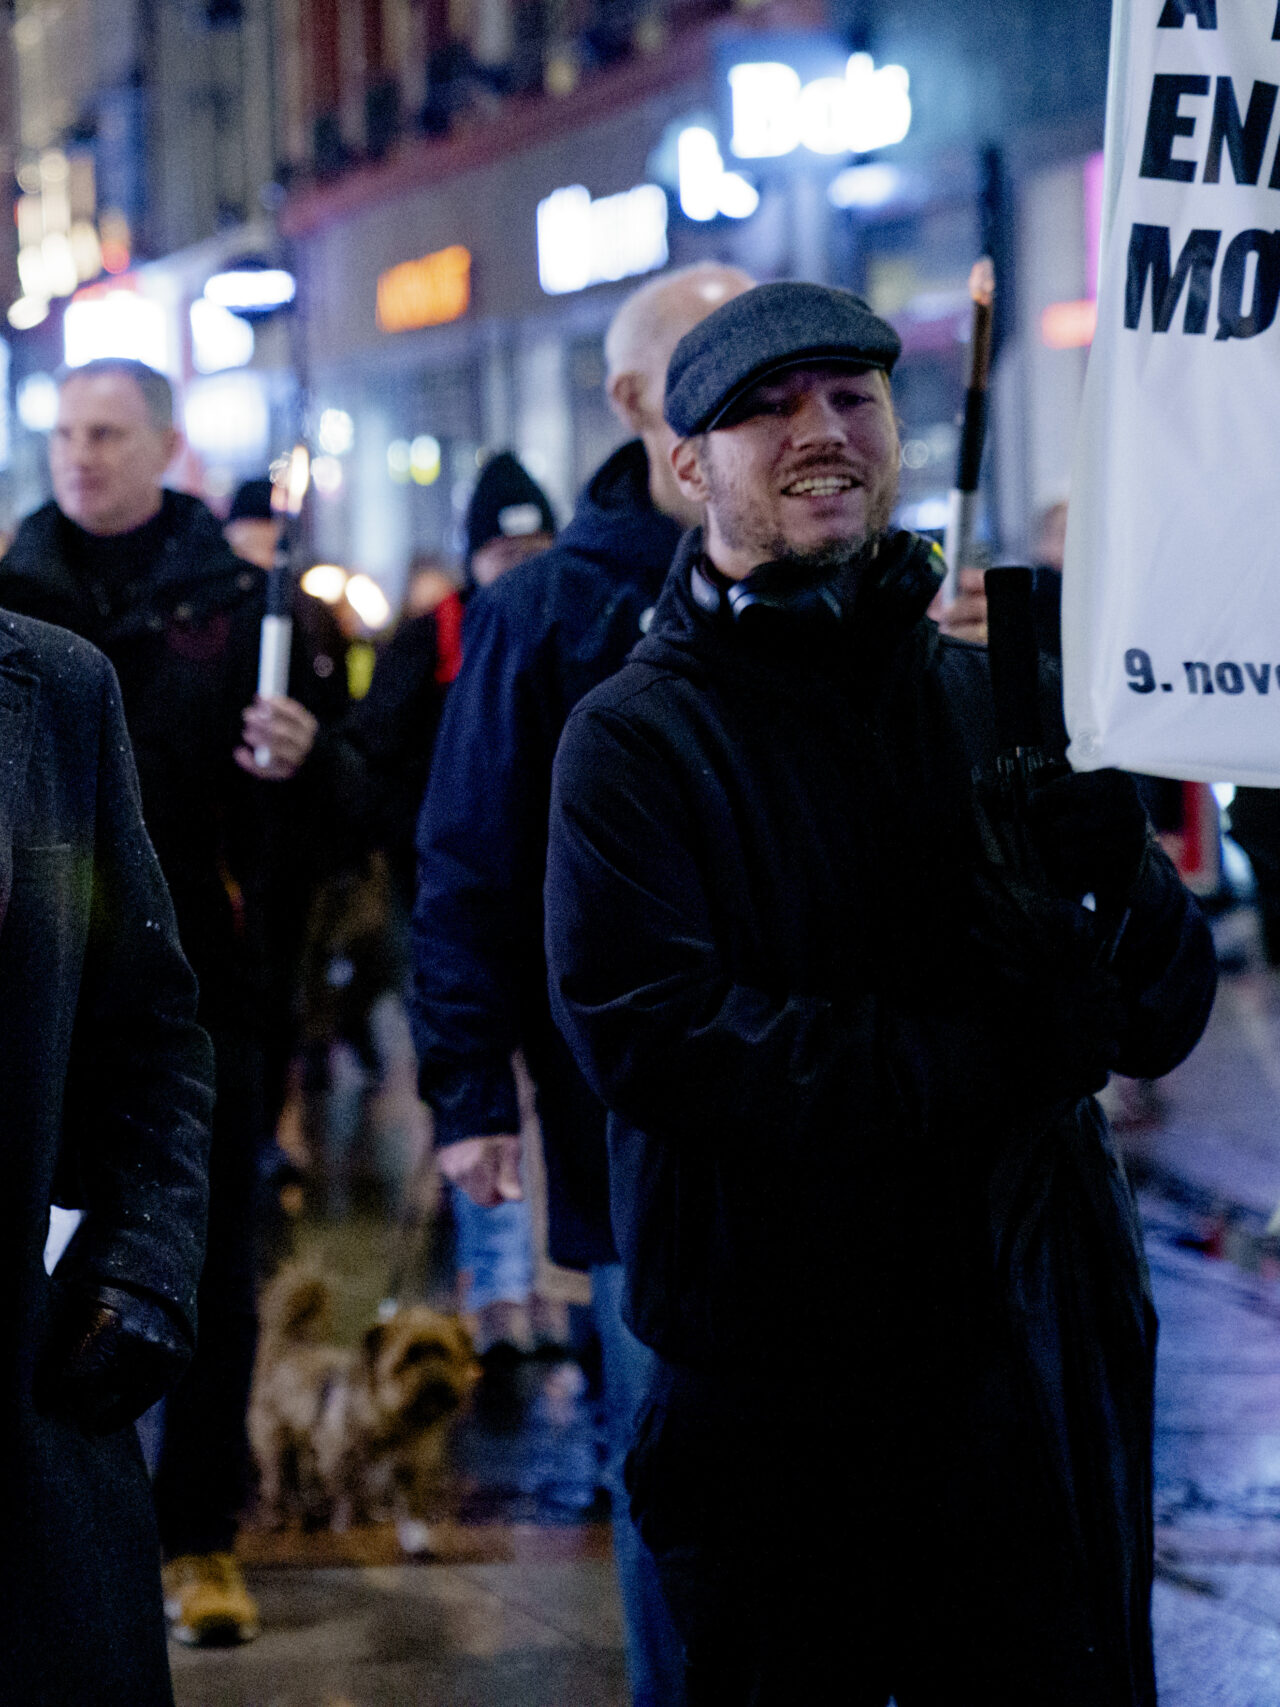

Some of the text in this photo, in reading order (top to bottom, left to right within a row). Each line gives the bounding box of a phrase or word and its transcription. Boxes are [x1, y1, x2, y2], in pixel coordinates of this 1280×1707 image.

[1139, 73, 1280, 190] EN
[1124, 648, 1280, 695] 9. nov
